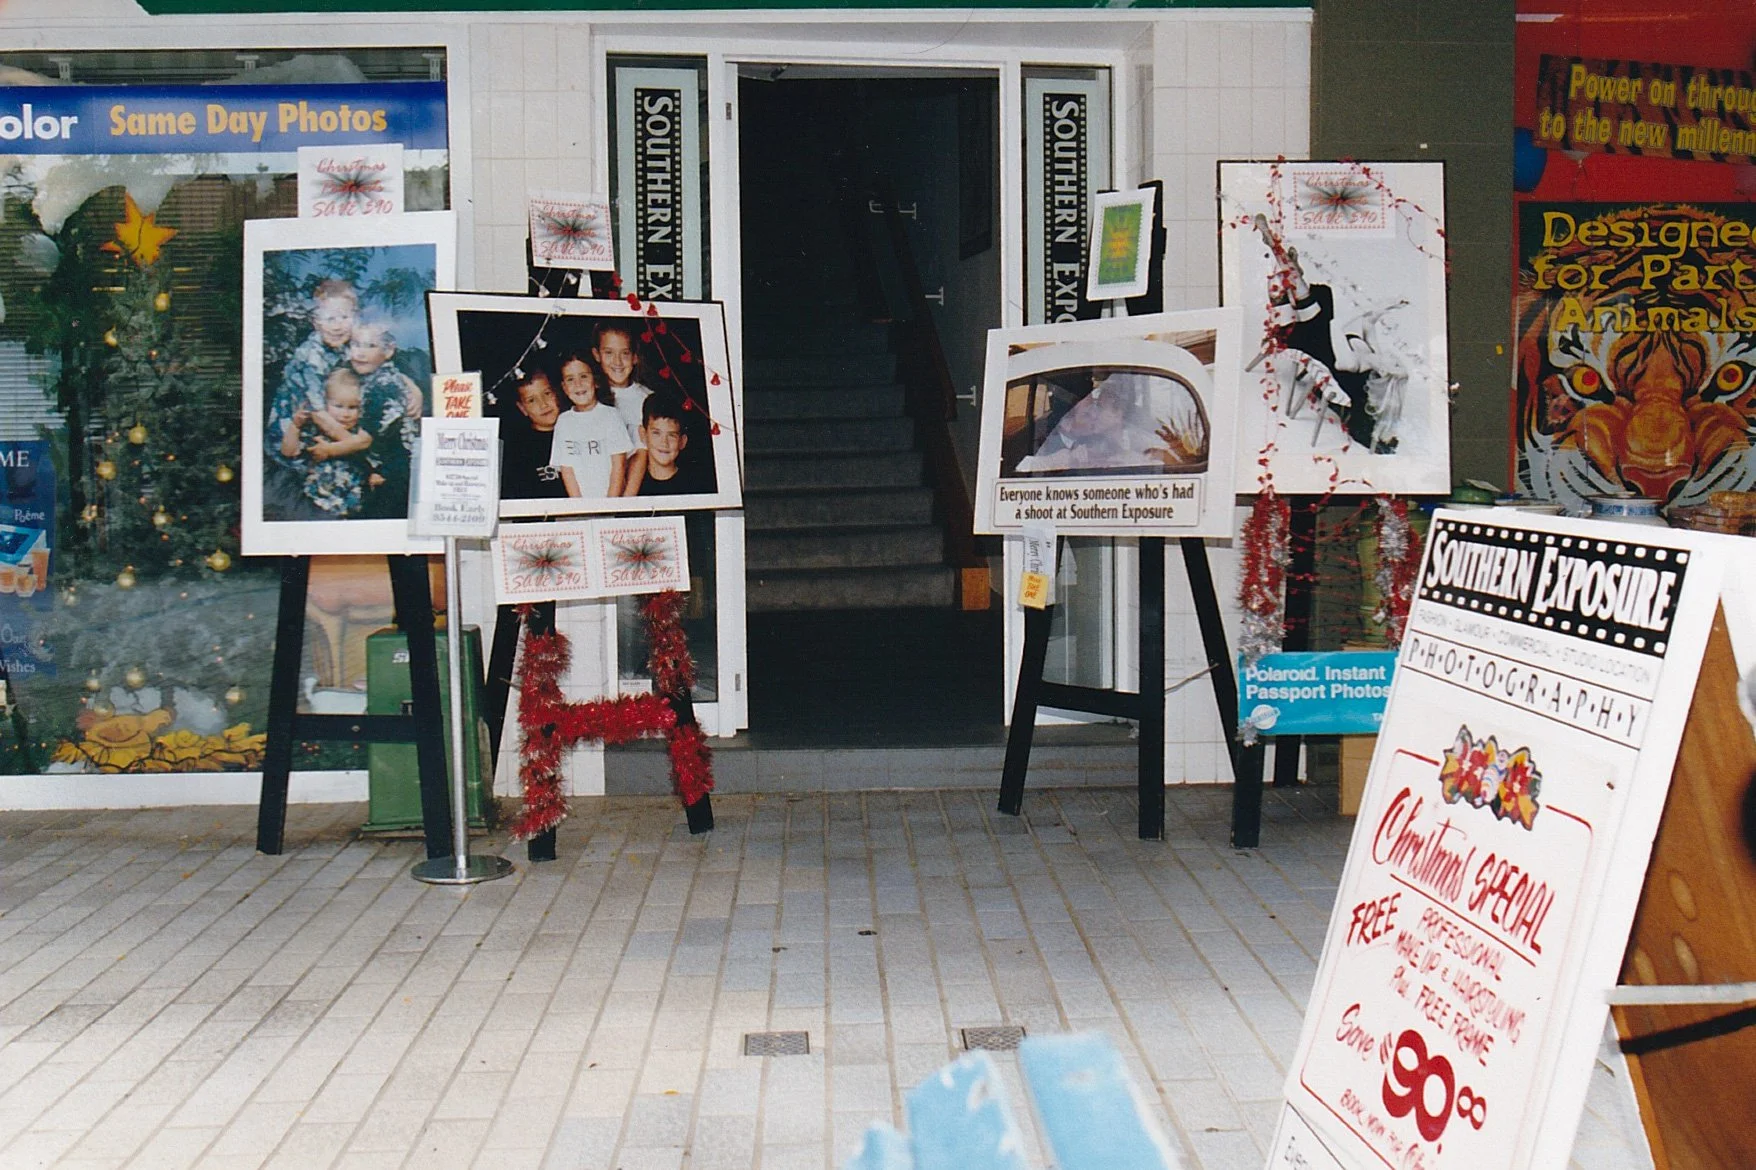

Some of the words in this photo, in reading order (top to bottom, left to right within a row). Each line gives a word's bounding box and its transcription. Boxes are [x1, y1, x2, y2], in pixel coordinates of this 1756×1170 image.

[1568, 63, 1644, 105] Power
[1649, 78, 1677, 108] on
[110, 105, 197, 136] Same
[207, 103, 267, 142] Day
[278, 101, 387, 132] Photos
[1539, 106, 1566, 140] to
[1573, 106, 1612, 144] the
[1618, 120, 1669, 148] new
[316, 158, 386, 173] Christmas
[643, 96, 674, 244] SOUTHERN
[1051, 100, 1080, 243] SOUTHERN
[1305, 175, 1369, 188] Christmas
[312, 200, 356, 217] SAVE
[1302, 211, 1342, 226] SAVE
[1543, 211, 1756, 259] Designe
[1533, 254, 1616, 290] for
[1556, 297, 1756, 332] Animals
[445, 395, 473, 410] TAKE
[1000, 486, 1042, 505] Everyone
[1046, 486, 1079, 501] knows
[1083, 486, 1131, 500] someone
[1135, 483, 1169, 499] who's
[1172, 483, 1194, 499] had
[1015, 508, 1021, 519] a
[1025, 504, 1053, 520] shoot
[1056, 506, 1066, 519] at
[1070, 503, 1118, 519] Southern
[1122, 503, 1174, 523] Exposure
[512, 538, 573, 551] Christmas
[611, 533, 666, 546] Christmas
[512, 573, 551, 590] SAVE
[611, 567, 646, 584] SAVE
[1426, 530, 1538, 604] SOUTHERN
[1531, 546, 1677, 631] EXPOSURE
[1325, 666, 1386, 681] Instant
[1246, 684, 1326, 703] Passport
[1331, 683, 1392, 699] Photos
[1372, 787, 1477, 902] Christmas
[1468, 853, 1555, 955] SPECIAL
[1347, 892, 1401, 947] FREE
[1335, 1003, 1374, 1061] Save
[1414, 984, 1451, 1029] FREE
[1448, 1012, 1494, 1066] FRAME
